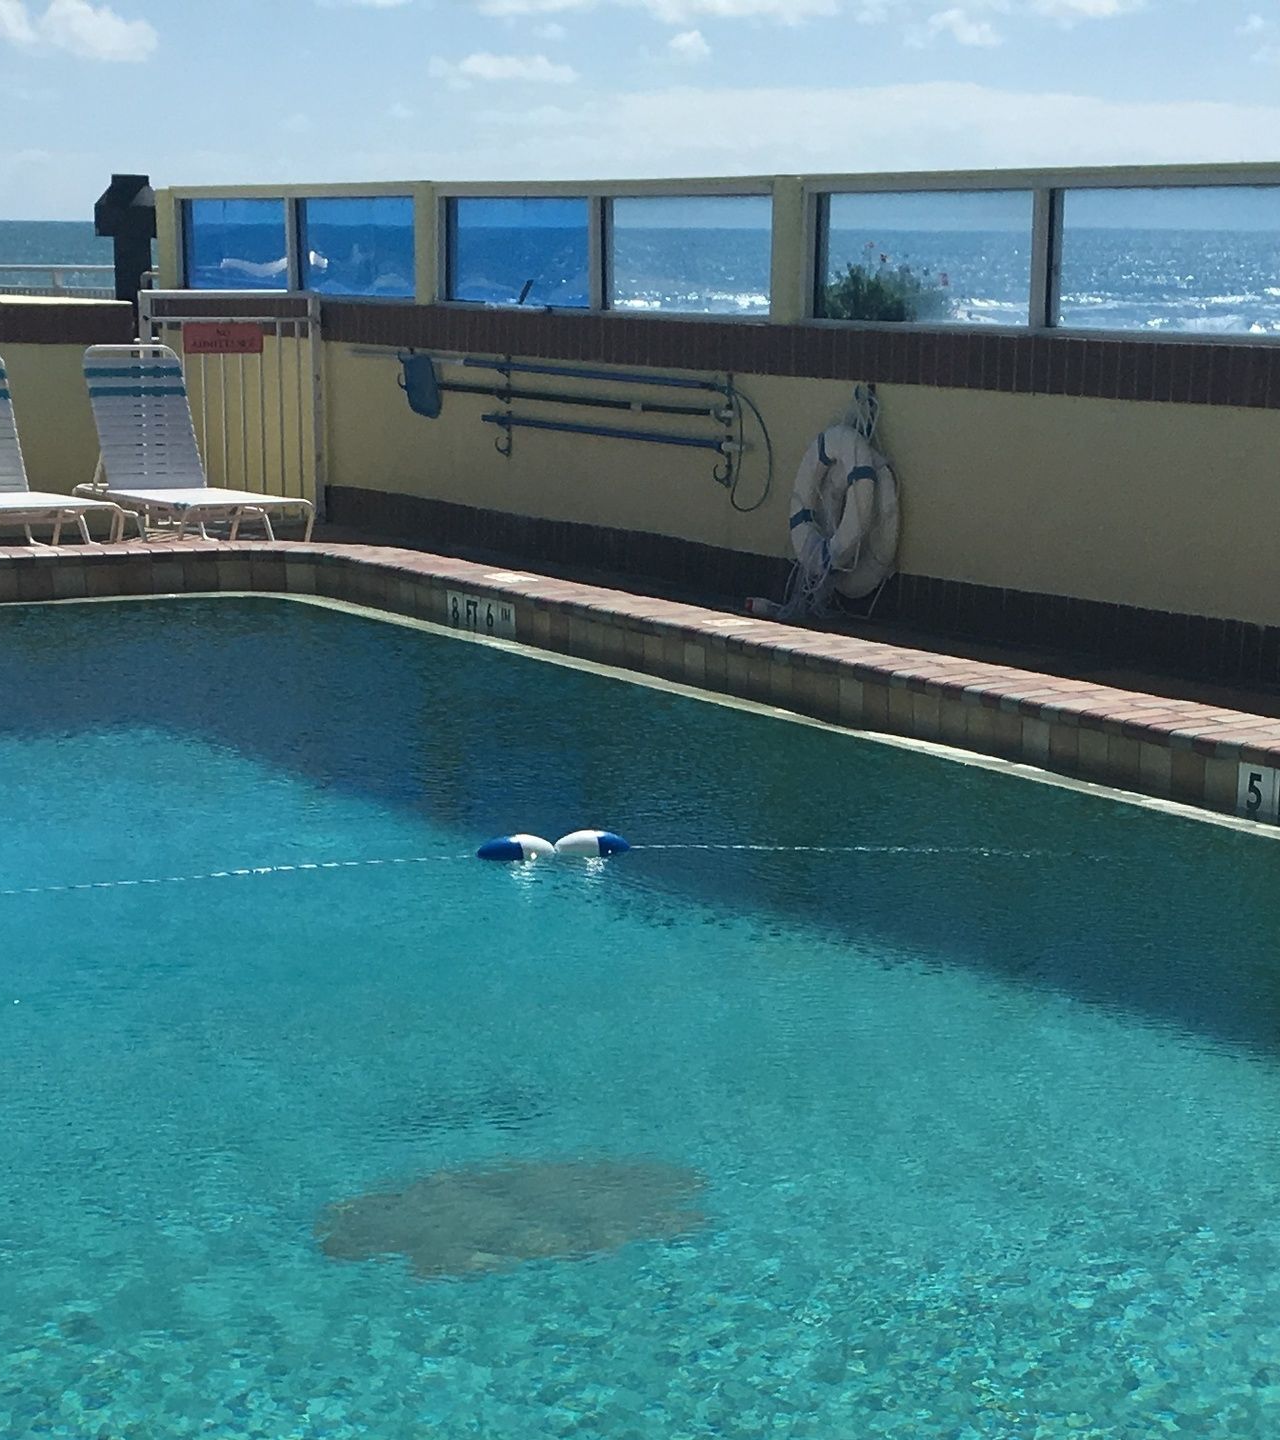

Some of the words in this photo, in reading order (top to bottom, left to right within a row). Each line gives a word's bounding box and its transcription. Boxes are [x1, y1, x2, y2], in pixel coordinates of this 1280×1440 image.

[452, 597, 459, 620] 8
[467, 600, 477, 626] FT
[487, 603, 494, 627] 6
[1247, 773, 1262, 810] 5
